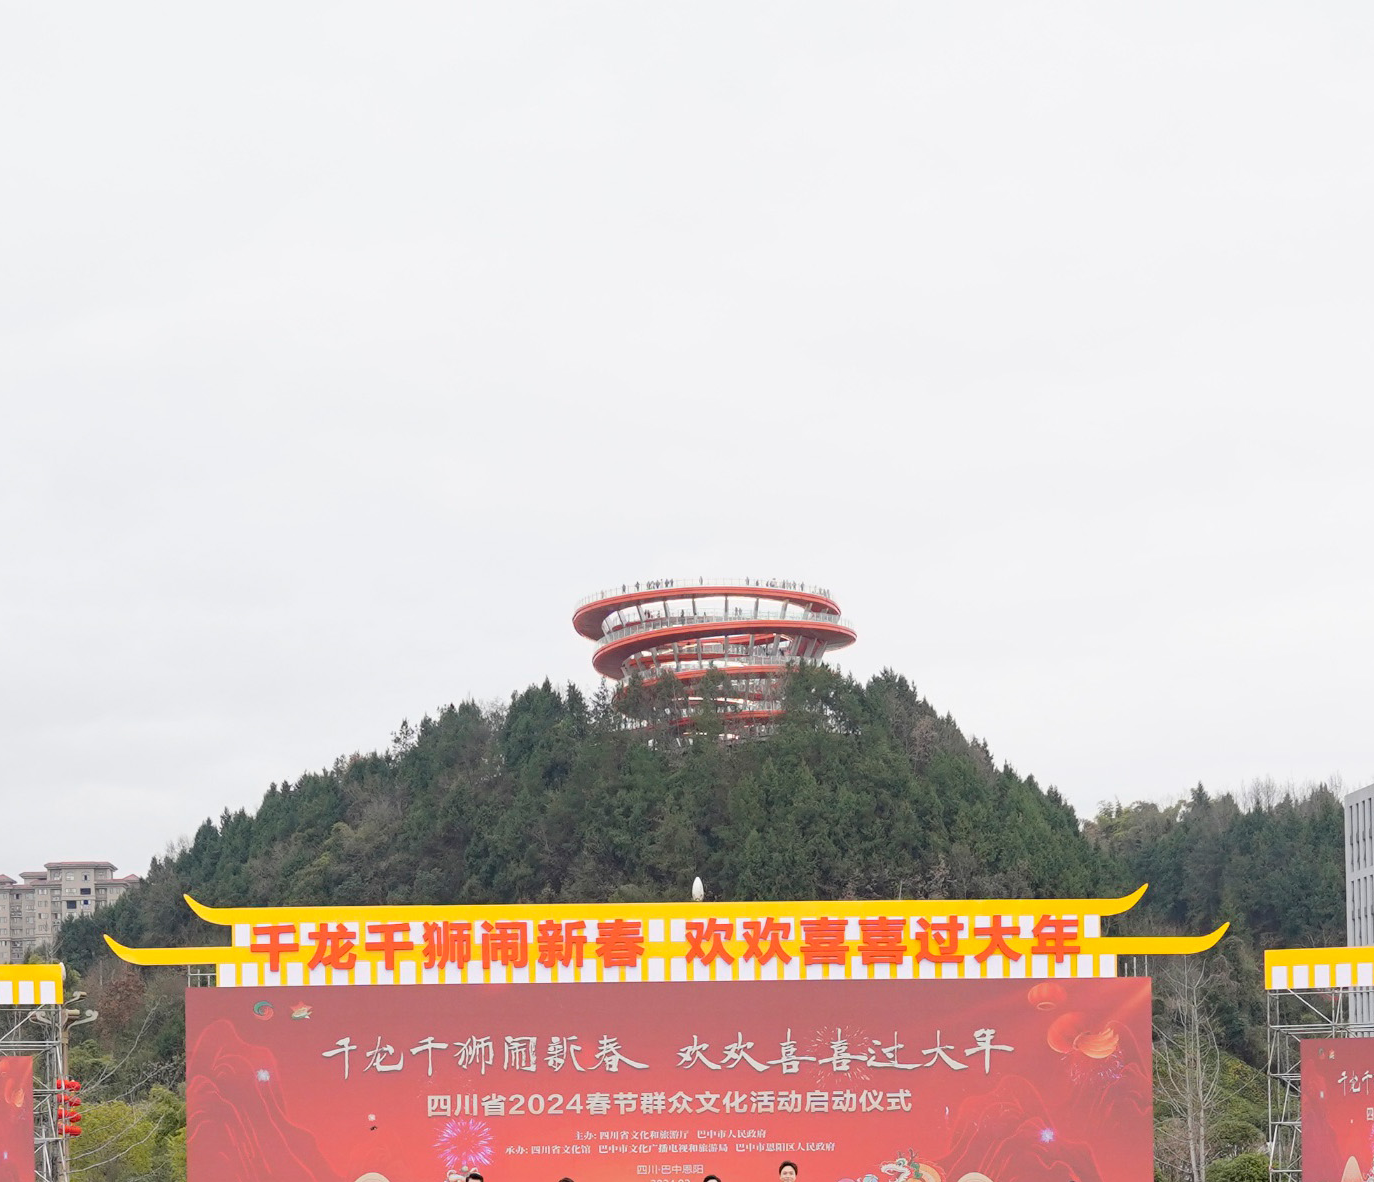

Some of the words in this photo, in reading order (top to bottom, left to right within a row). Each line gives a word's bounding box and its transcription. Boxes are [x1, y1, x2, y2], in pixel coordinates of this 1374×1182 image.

[249, 918, 646, 972] 千龙千狮闹新春
[684, 914, 1081, 967] 欢欢喜喜过大年
[321, 1034, 650, 1079] 千龙千狮闹新春
[675, 1027, 1014, 1075] 欢欢喜喜过大年
[427, 1089, 913, 1117] 四川省2024春节群众文化活动启动仪式
